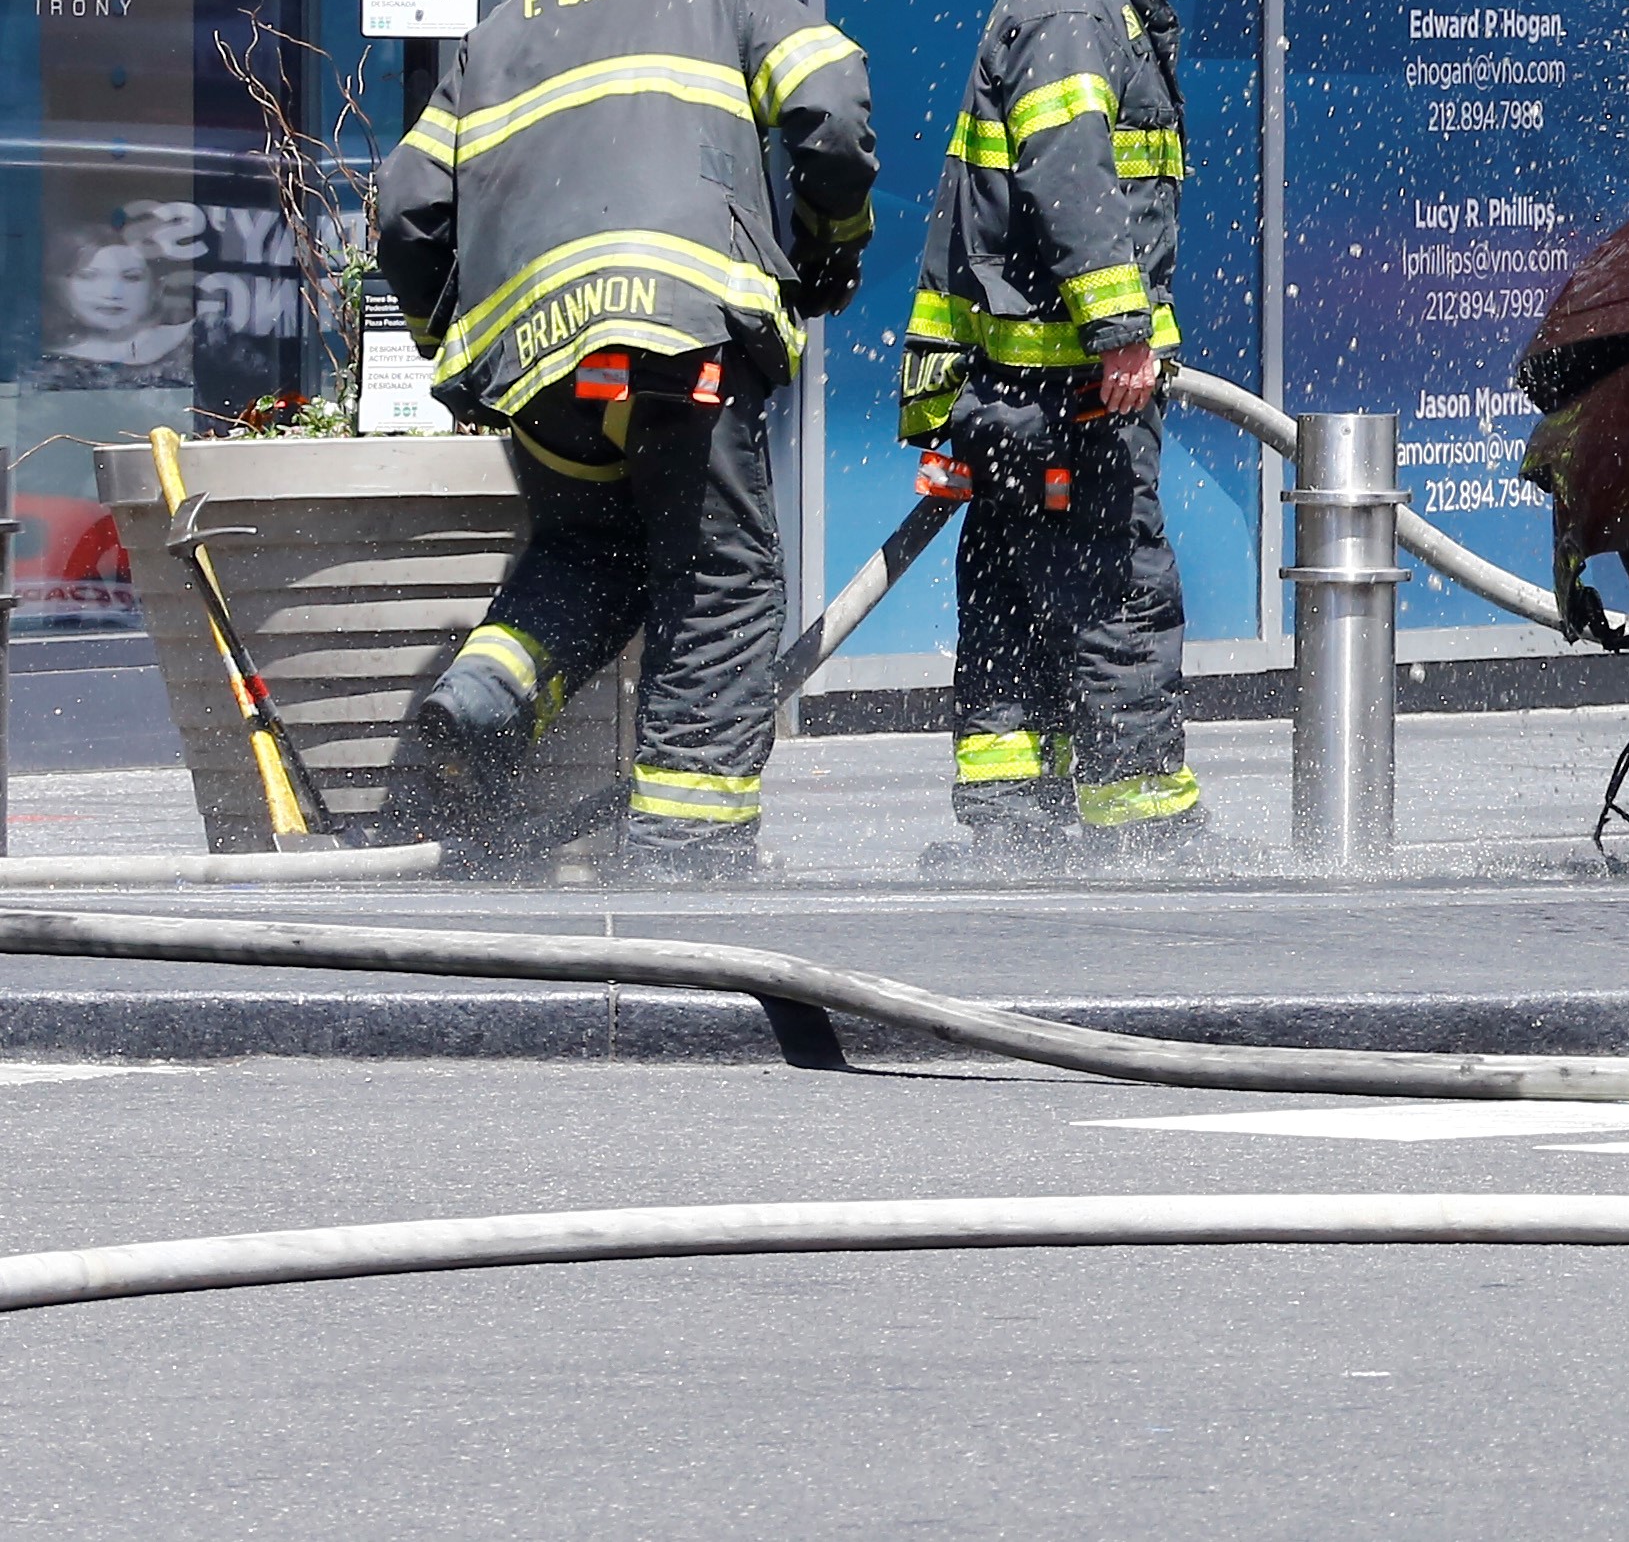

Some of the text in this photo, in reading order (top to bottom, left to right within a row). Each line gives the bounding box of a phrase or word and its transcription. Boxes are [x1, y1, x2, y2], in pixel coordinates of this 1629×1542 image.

[1409, 8, 1479, 39] Edward
[1502, 9, 1562, 44] Hogan
[1405, 54, 1566, 91] ehogan@vno.com
[1414, 195, 1556, 234] Lucy R. Phillips
[1402, 242, 1569, 281] lphillips@vno.com
[514, 276, 657, 370] BRANNON
[1425, 289, 1547, 321] 212.894.7992
[1415, 389, 1471, 419] Jason
